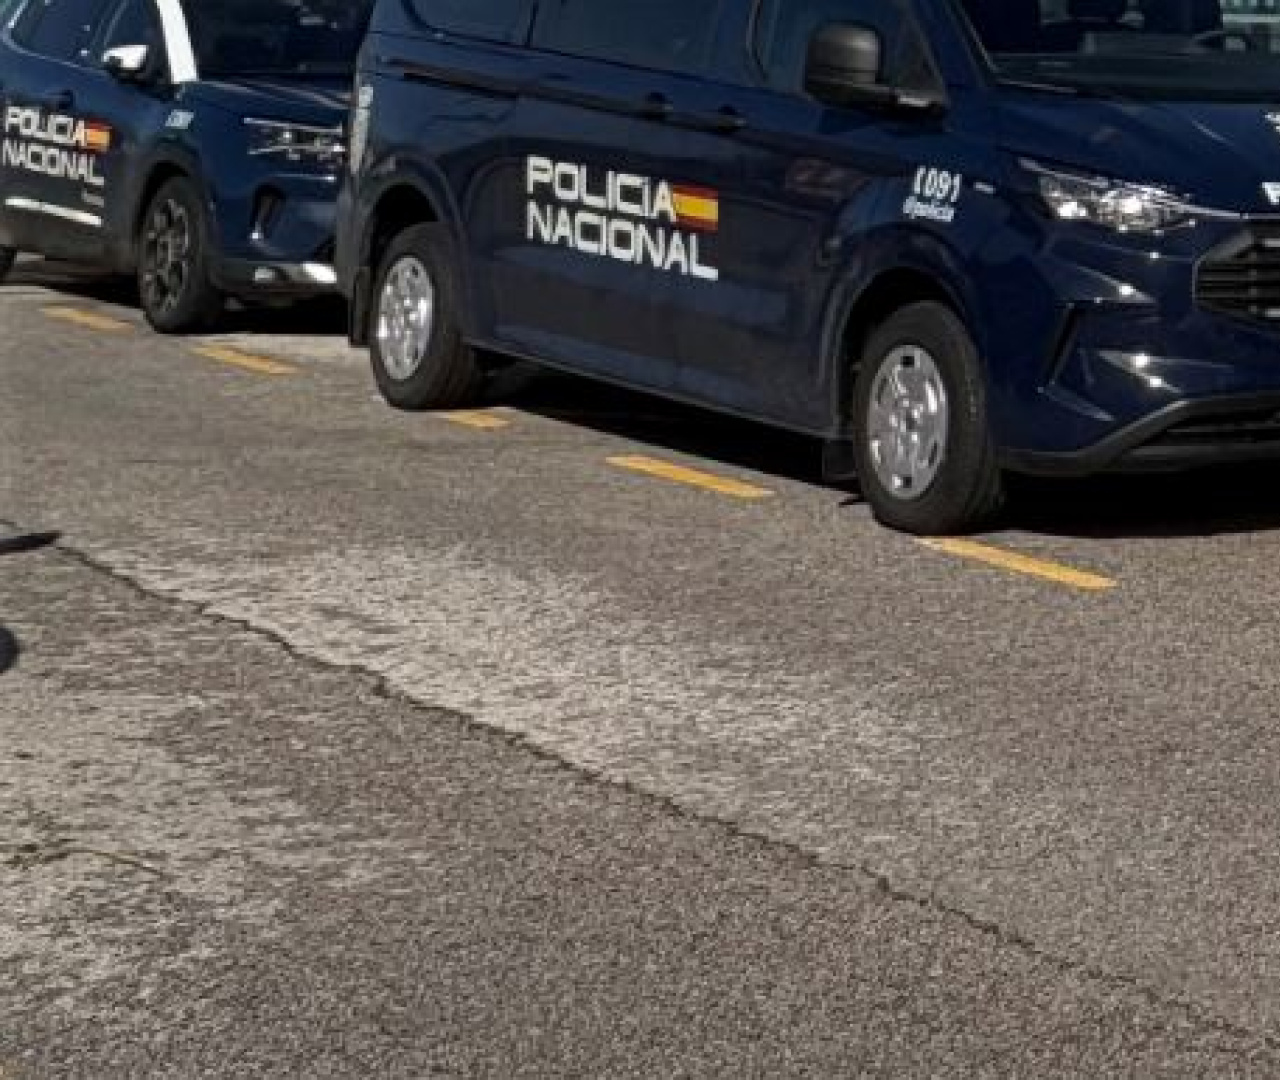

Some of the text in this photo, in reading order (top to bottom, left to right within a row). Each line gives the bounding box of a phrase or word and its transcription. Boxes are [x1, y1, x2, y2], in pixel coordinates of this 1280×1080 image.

[2, 139, 105, 186] NACIONAL
[923, 168, 961, 202] 091
[526, 199, 719, 280] NACIONAL
